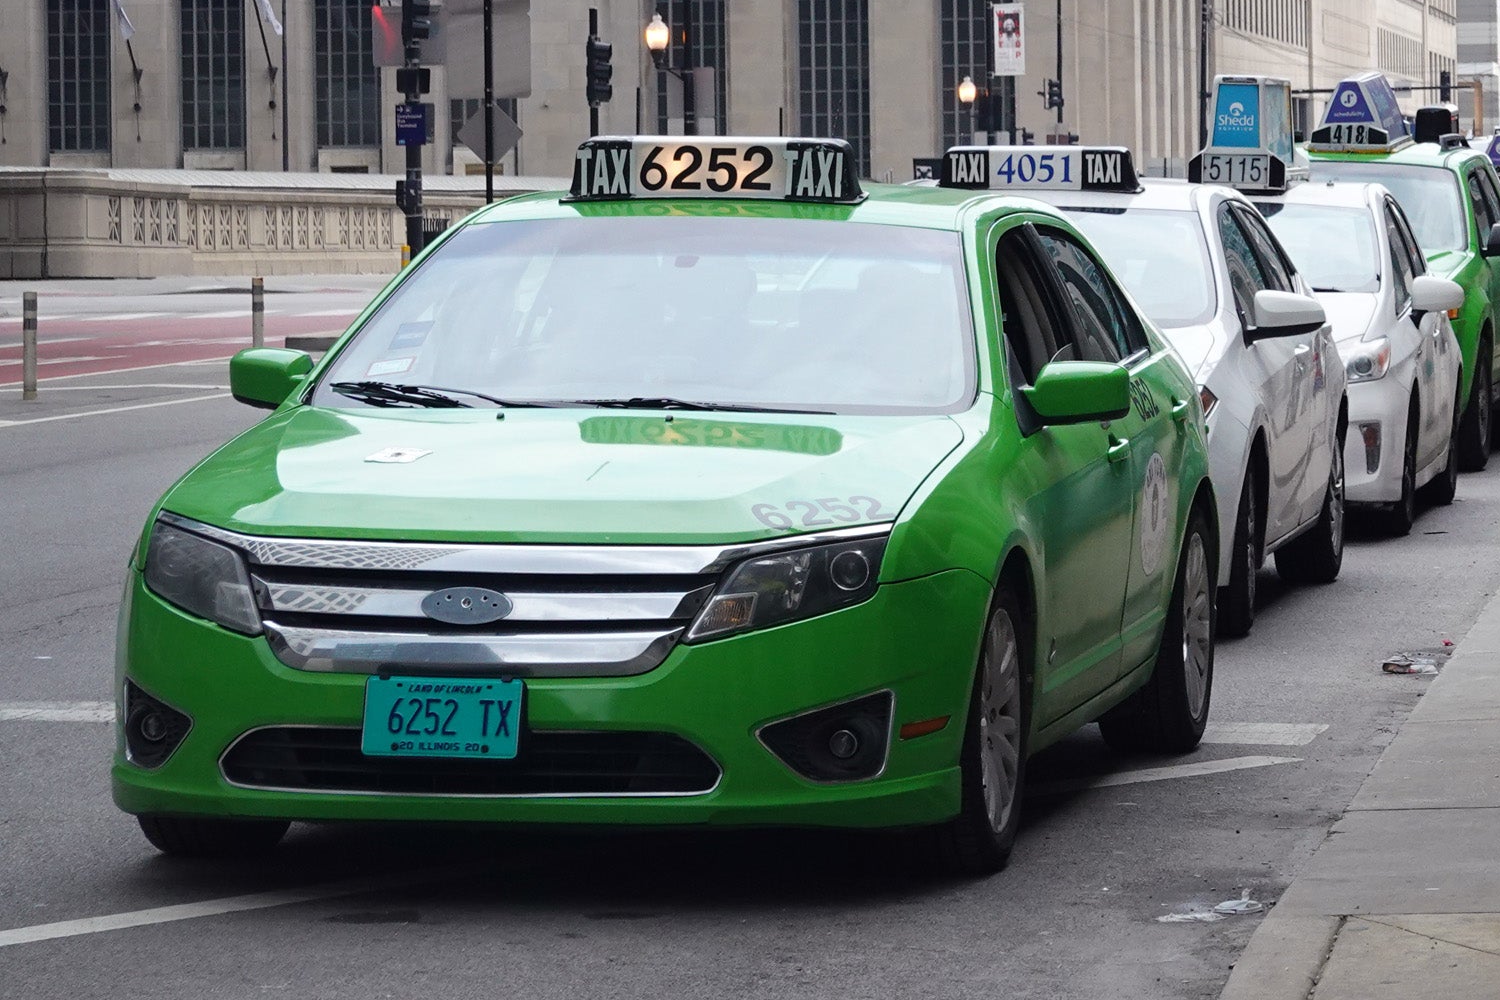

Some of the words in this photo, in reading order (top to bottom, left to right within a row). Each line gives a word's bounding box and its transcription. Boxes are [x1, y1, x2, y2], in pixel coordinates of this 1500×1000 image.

[1218, 114, 1254, 126] Shedd
[577, 148, 635, 196] TAXI
[639, 145, 774, 193] 6252
[783, 150, 844, 198] TAXI
[950, 153, 985, 183] TAXI
[997, 153, 1073, 184] 4051
[1085, 153, 1122, 184] TAXI
[1209, 156, 1261, 182] 5115
[751, 495, 896, 531] 6252
[408, 683, 432, 693] LAND
[434, 683, 445, 693] OF
[446, 684, 483, 694] LINCOLN
[387, 697, 459, 736] 6252
[479, 699, 513, 737] TX
[399, 741, 414, 750] 20
[418, 741, 460, 751] ILLINOIS
[465, 742, 480, 752] 20
